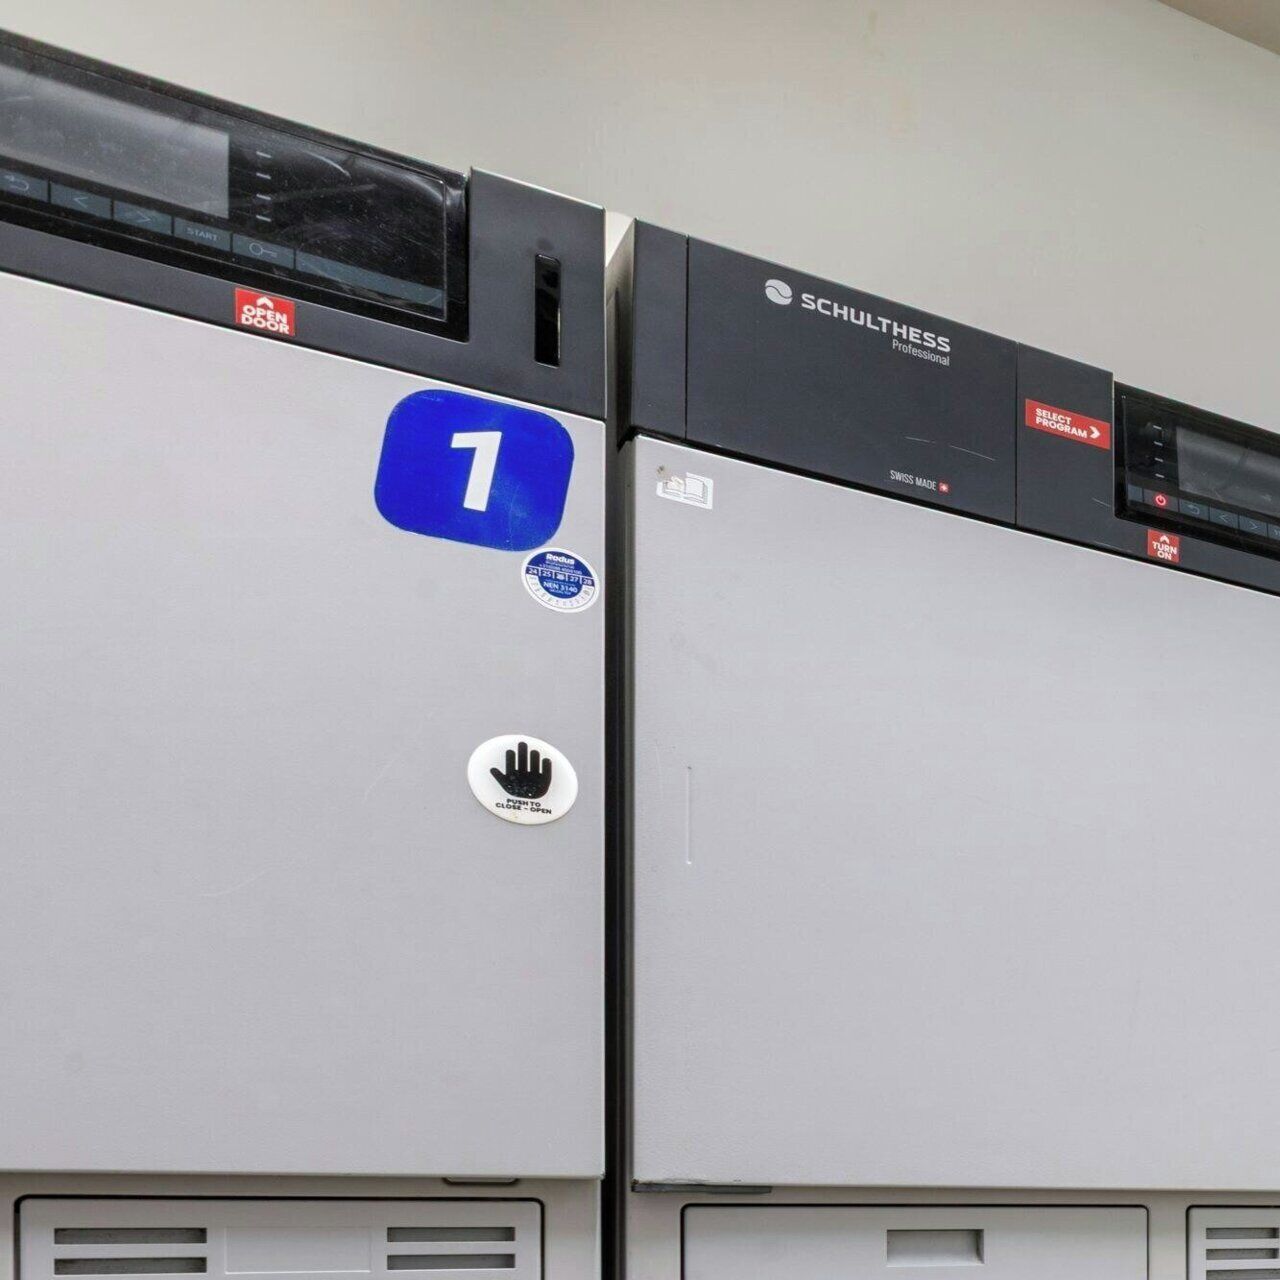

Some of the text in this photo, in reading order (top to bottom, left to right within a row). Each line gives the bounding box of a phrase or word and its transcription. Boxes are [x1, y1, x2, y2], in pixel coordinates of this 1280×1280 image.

[186, 227, 218, 241] START
[242, 305, 288, 324] OPEN
[801, 293, 950, 353] SCHULTHESS
[241, 314, 289, 334] DOOR
[892, 339, 950, 366] Professional
[1035, 408, 1071, 425] SELECT
[1035, 417, 1087, 438] PROGRAM
[449, 431, 502, 511] 1
[890, 470, 937, 491] SWISS MADE
[1152, 542, 1177, 554] TURN
[1158, 552, 1172, 560] ON
[546, 553, 575, 565] Rodus
[496, 802, 521, 810] CLOSE
[507, 798, 528, 806] PUSH
